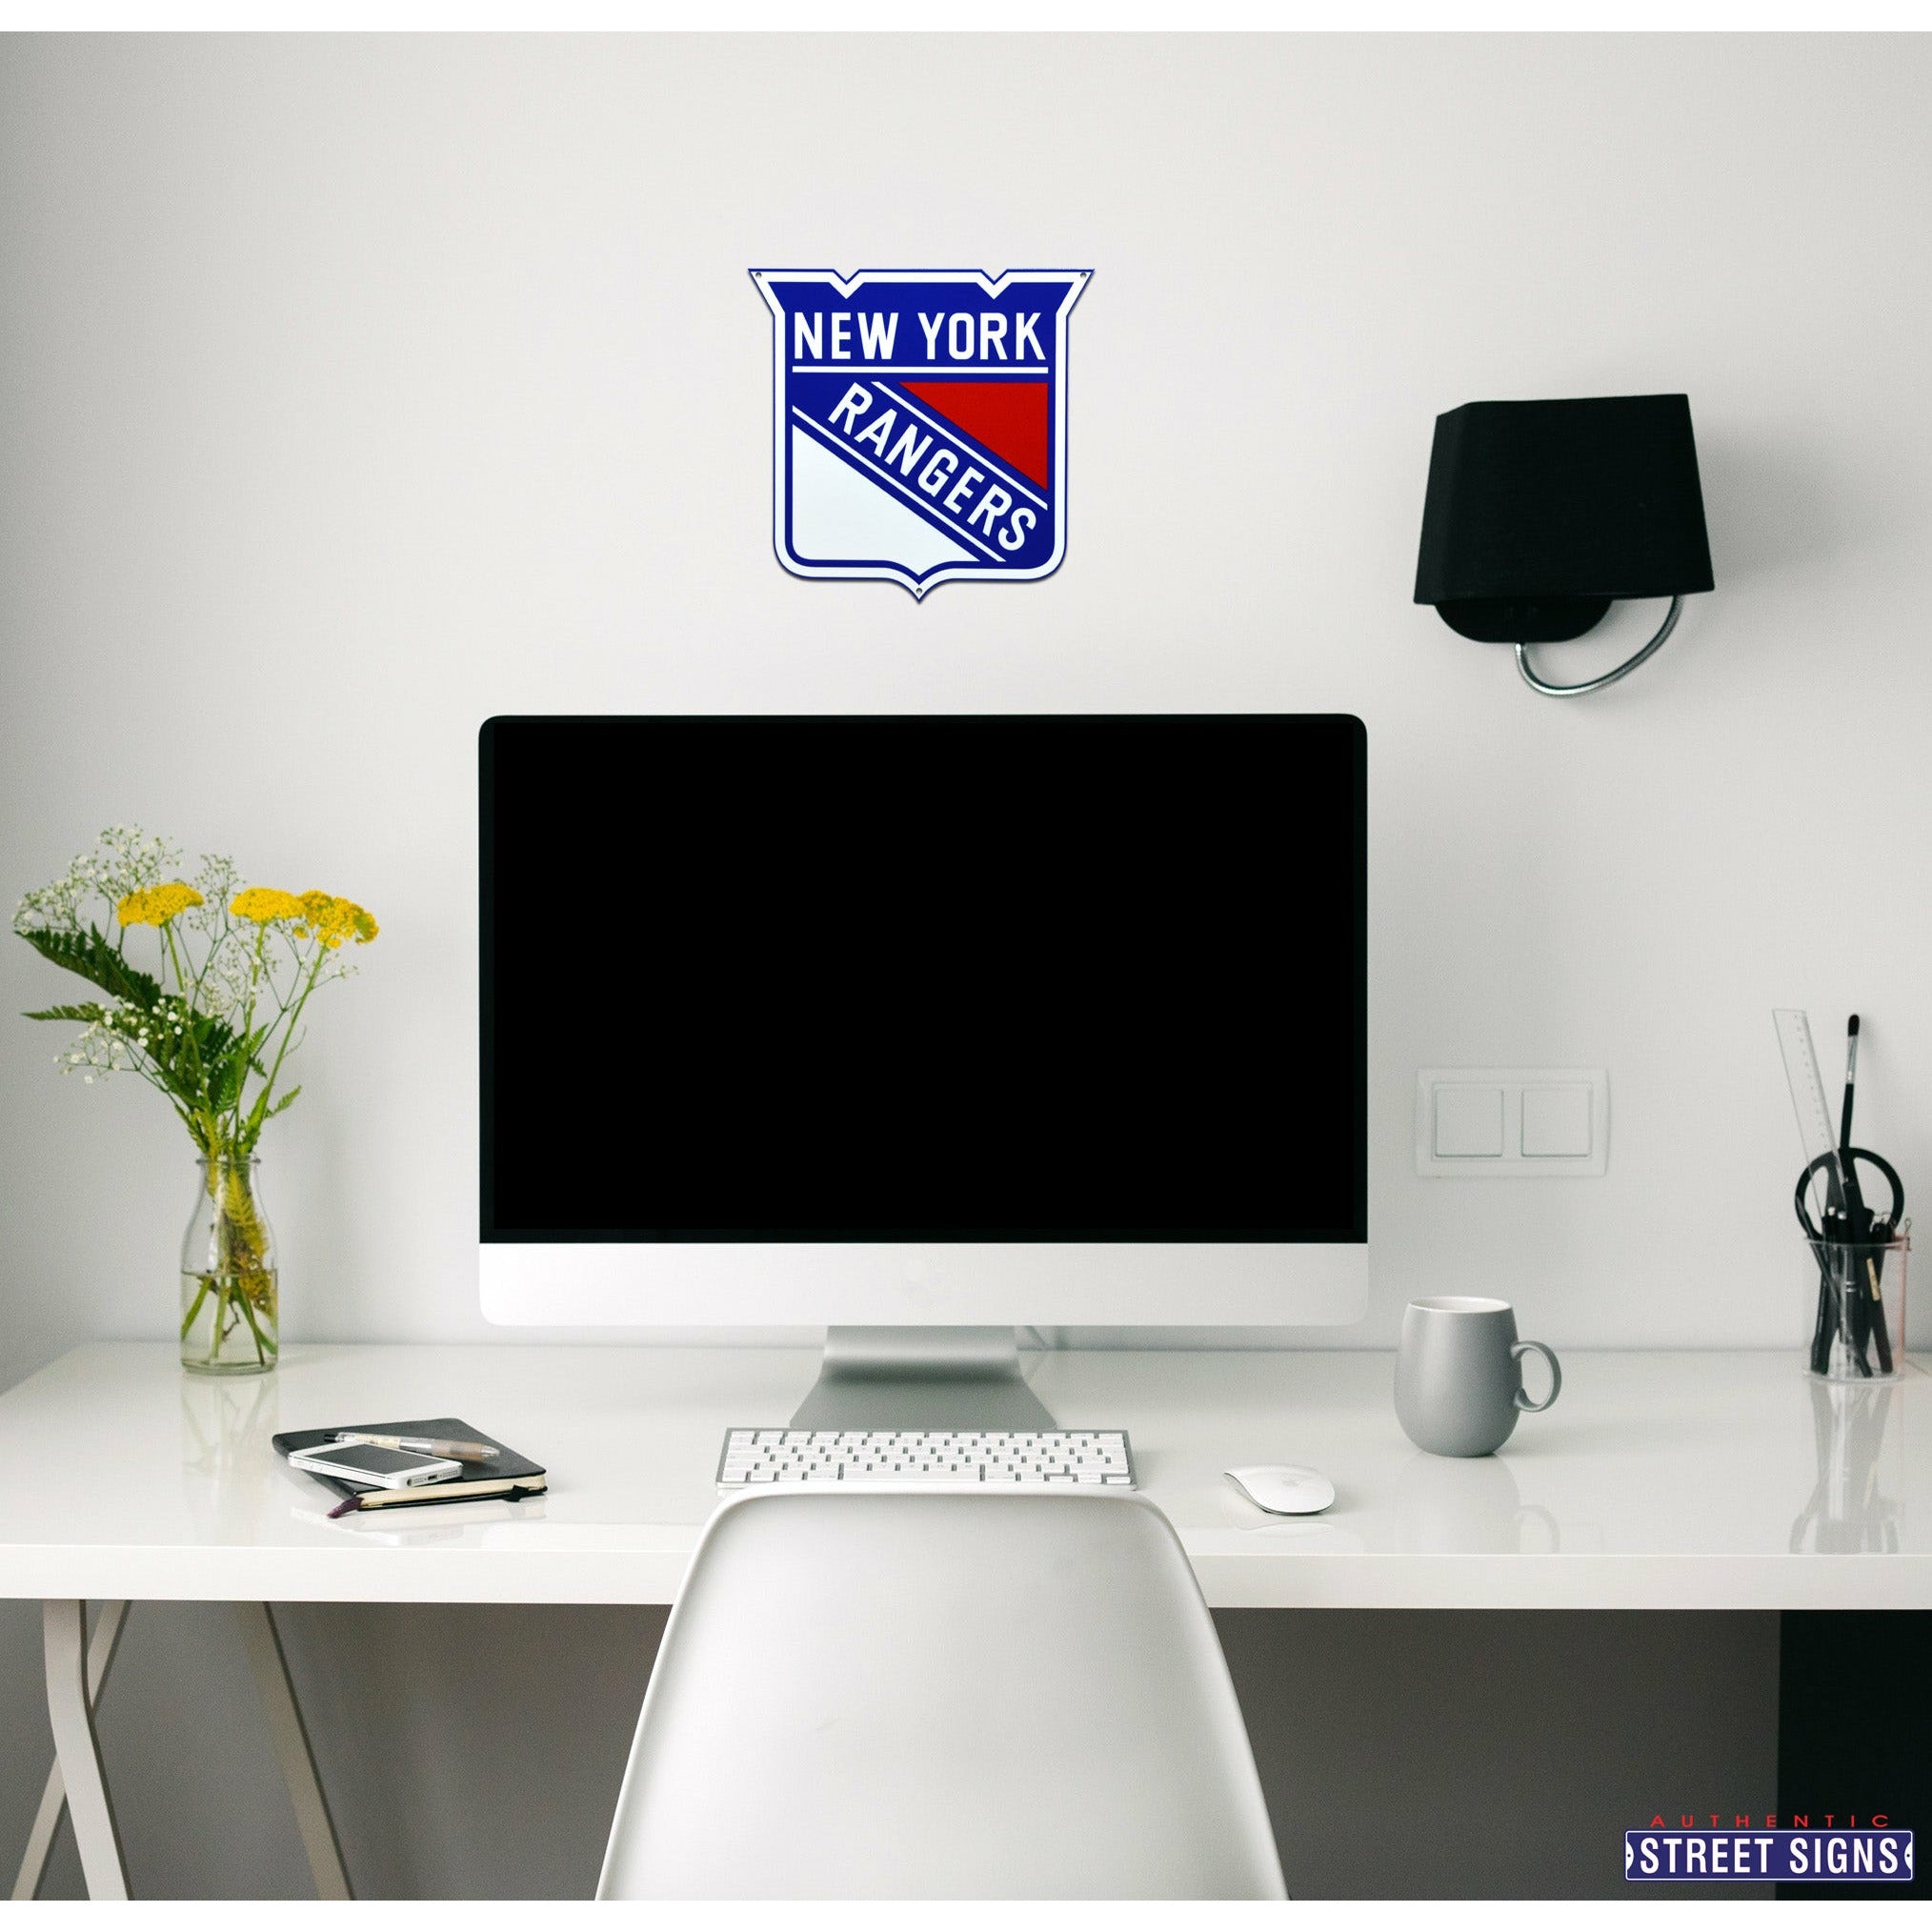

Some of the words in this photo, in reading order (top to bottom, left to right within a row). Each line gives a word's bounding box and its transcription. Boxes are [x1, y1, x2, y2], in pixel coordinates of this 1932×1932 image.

[794, 312, 899, 360] NEW
[917, 312, 1047, 360] YORK
[827, 381, 1037, 551] RANGERS
